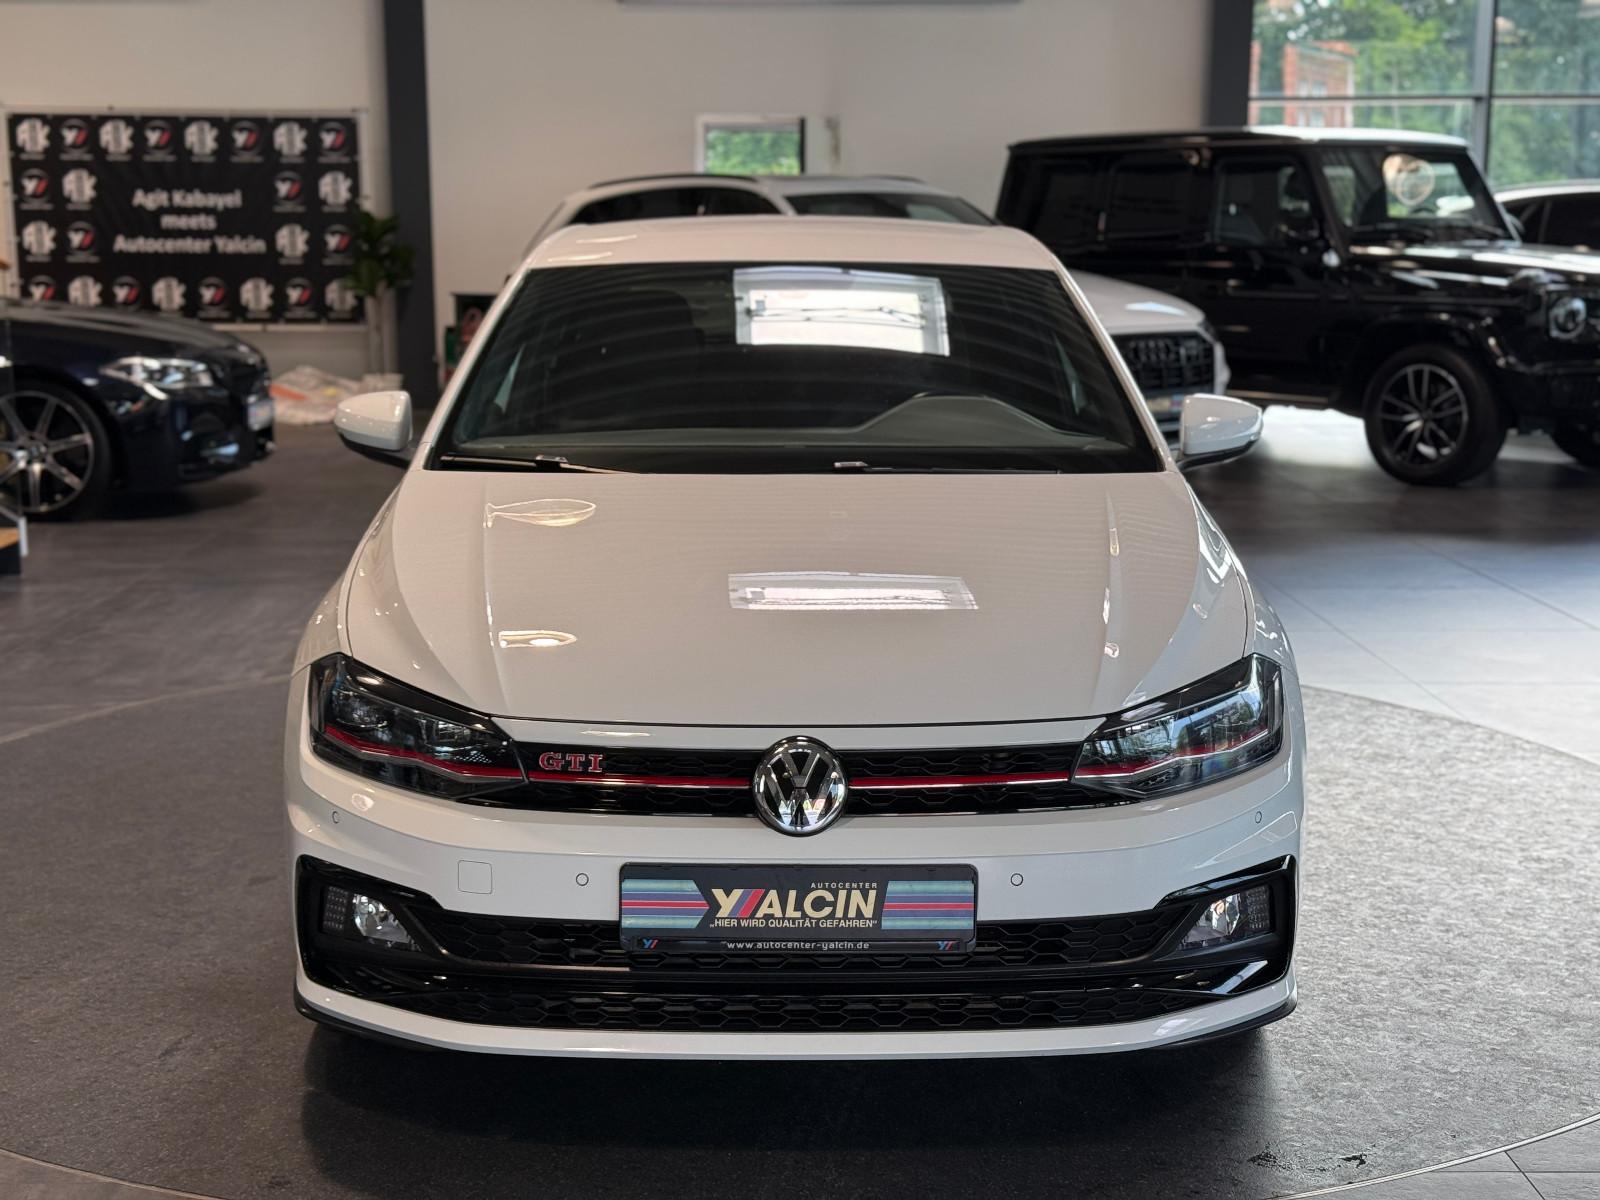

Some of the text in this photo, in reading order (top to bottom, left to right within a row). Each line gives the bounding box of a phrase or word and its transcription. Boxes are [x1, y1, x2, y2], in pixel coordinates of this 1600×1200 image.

[160, 214, 217, 230] meets
[113, 234, 212, 253] Autocenter
[539, 752, 603, 773] GTI
[741, 919, 766, 928] WIRD
[768, 918, 817, 928] QUALITÄT
[727, 941, 870, 950] www.autocenter-yalcin.de
